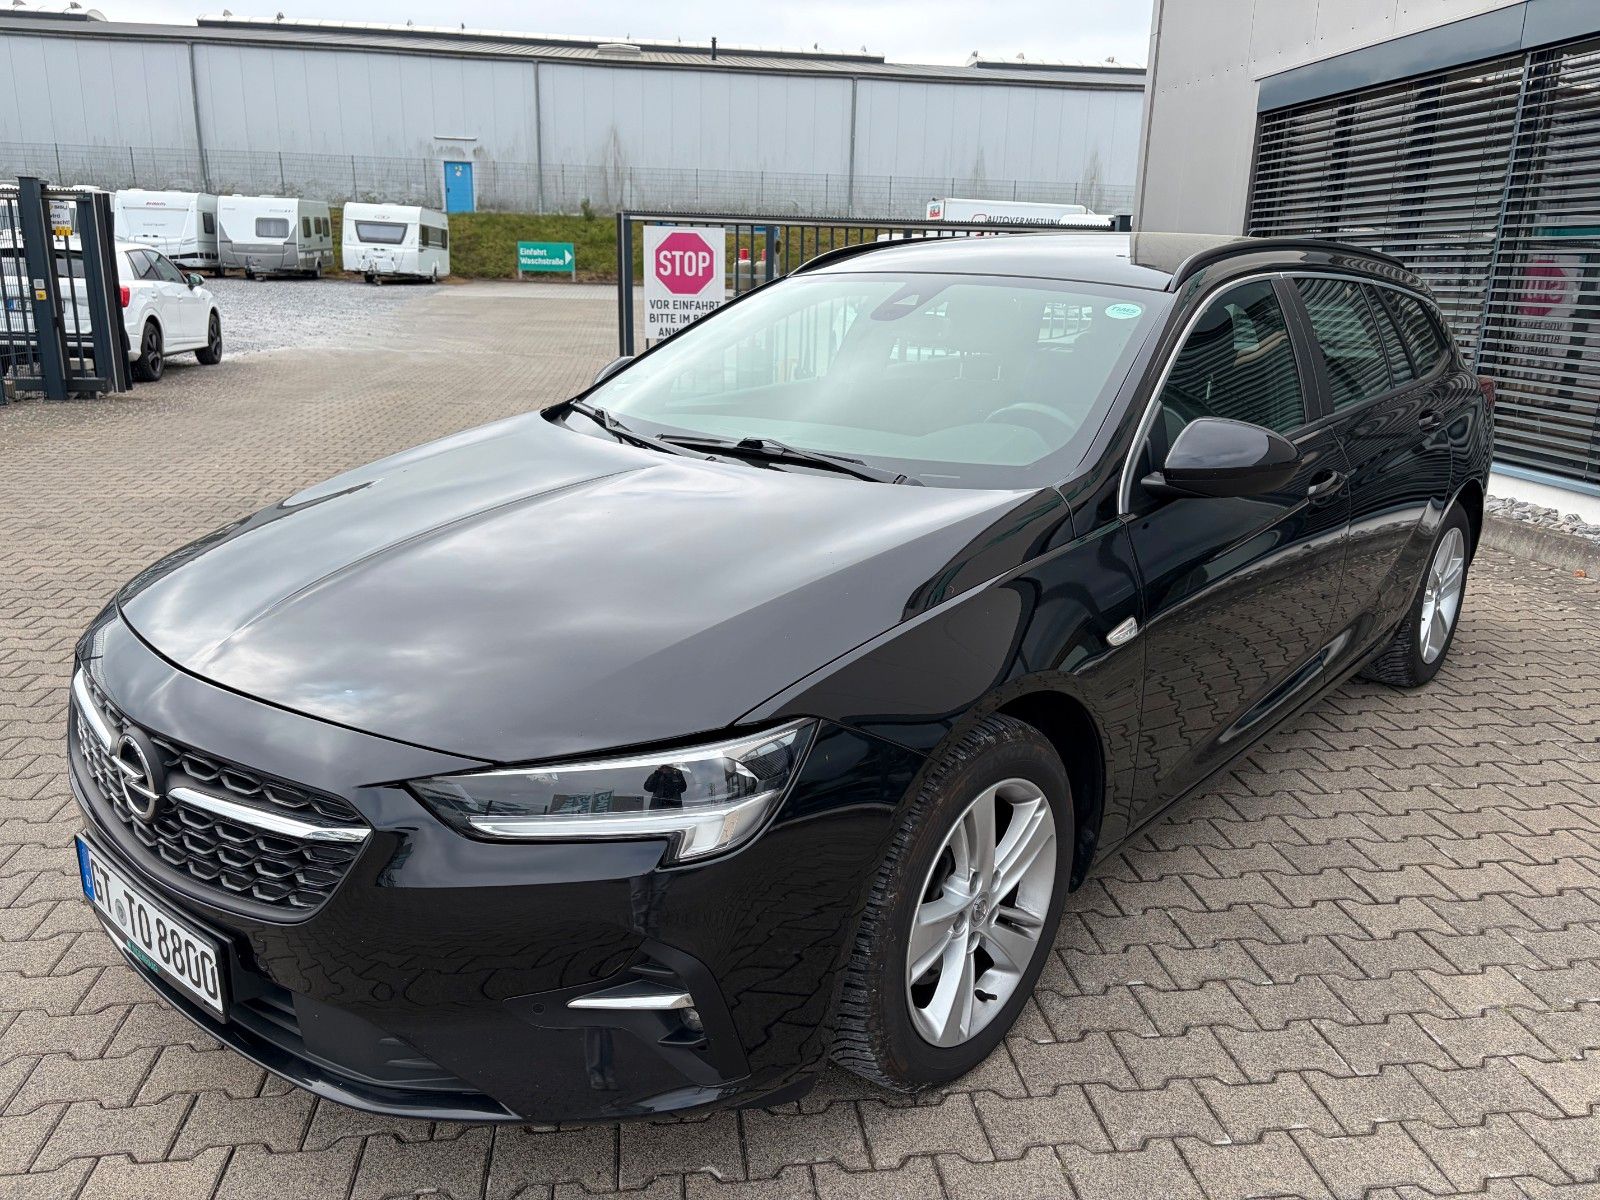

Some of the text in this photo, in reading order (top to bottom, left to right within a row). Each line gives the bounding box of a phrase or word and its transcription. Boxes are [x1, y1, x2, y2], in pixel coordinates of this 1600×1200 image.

[520, 247, 547, 256] Einfahrt
[520, 257, 564, 266] Waschstraße
[659, 250, 711, 276] STOP
[649, 299, 721, 311] VOR EINFAHRT
[649, 313, 677, 324] BITTE
[679, 313, 691, 324] IM
[90, 858, 112, 914] GT
[123, 889, 153, 951] TO
[155, 917, 218, 1001] 8800
